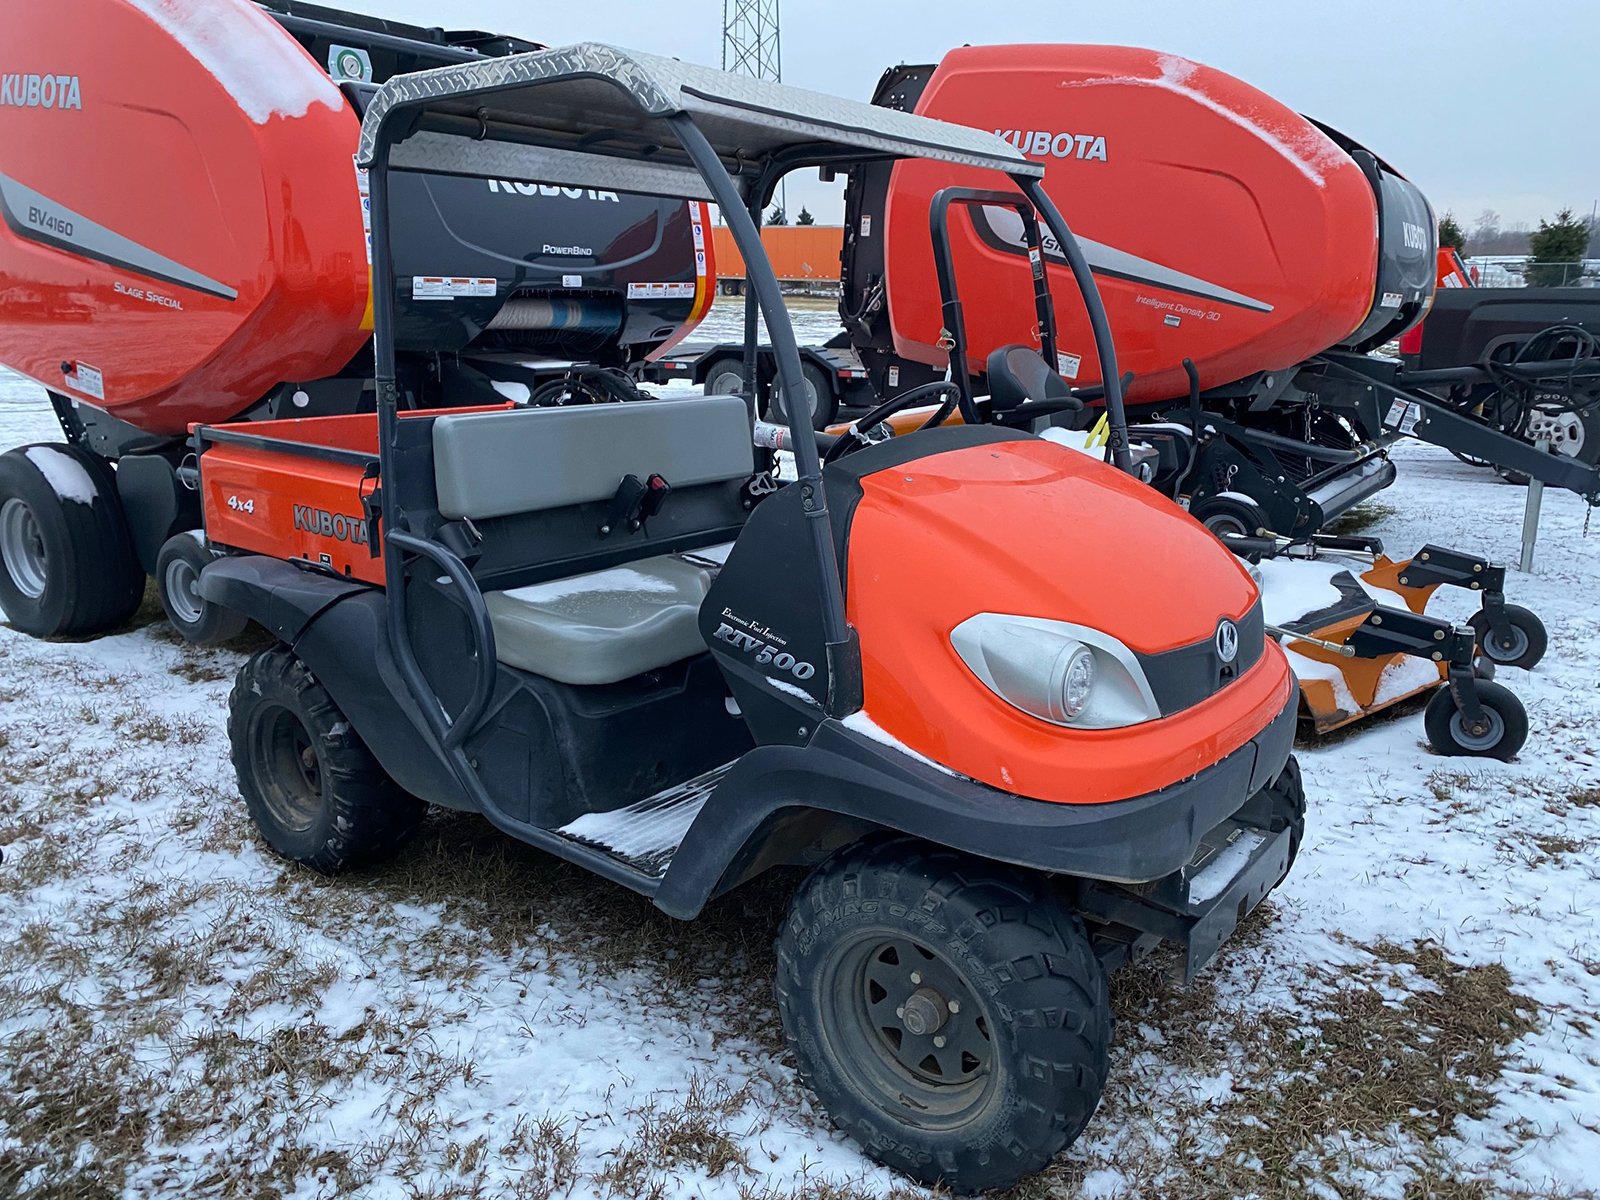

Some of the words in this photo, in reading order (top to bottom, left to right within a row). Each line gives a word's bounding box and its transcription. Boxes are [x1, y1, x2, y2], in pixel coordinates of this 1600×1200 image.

[1, 73, 82, 110] KUBOTA
[28, 206, 74, 237] BV4160
[1135, 294, 1175, 310] Intelligent
[1174, 303, 1207, 320] Density
[1206, 310, 1221, 321] 3D
[227, 495, 254, 514] 4x4
[293, 504, 369, 545] KUBOTA
[720, 607, 749, 628] Electronic
[748, 620, 764, 635] Fuel
[761, 627, 788, 646] Injection
